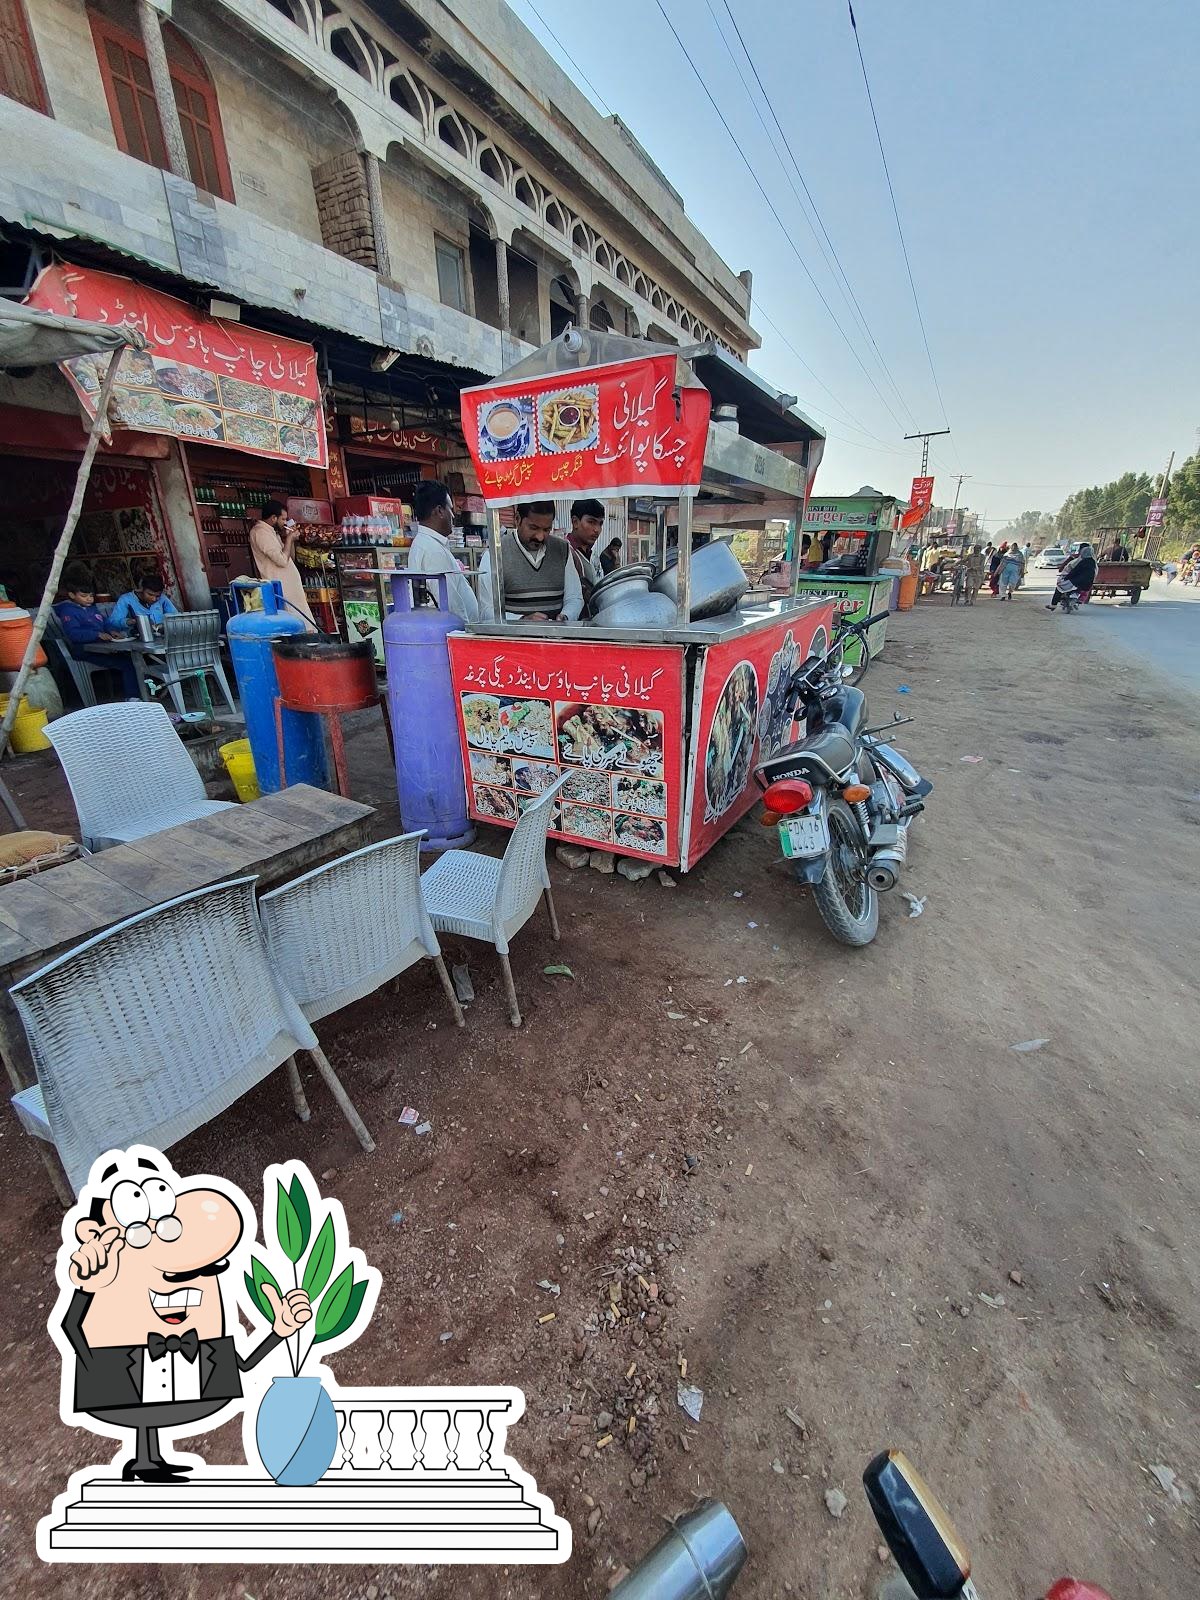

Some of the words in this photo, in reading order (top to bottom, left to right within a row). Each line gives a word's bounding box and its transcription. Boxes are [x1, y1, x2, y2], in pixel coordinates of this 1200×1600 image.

[153, 324, 209, 363] ہاؤس
[212, 347, 266, 381] چانپ
[269, 345, 315, 387] گیلانی
[613, 375, 669, 430] گیلانی
[594, 430, 651, 473] پوائنٹ
[803, 511, 847, 525] urger
[515, 665, 536, 690] اینڈ
[537, 669, 571, 697] ہاؤس
[573, 673, 614, 702] چانپ
[615, 665, 664, 701] گیلانی
[771, 767, 811, 782] HONDA
[809, 820, 819, 834] 16
